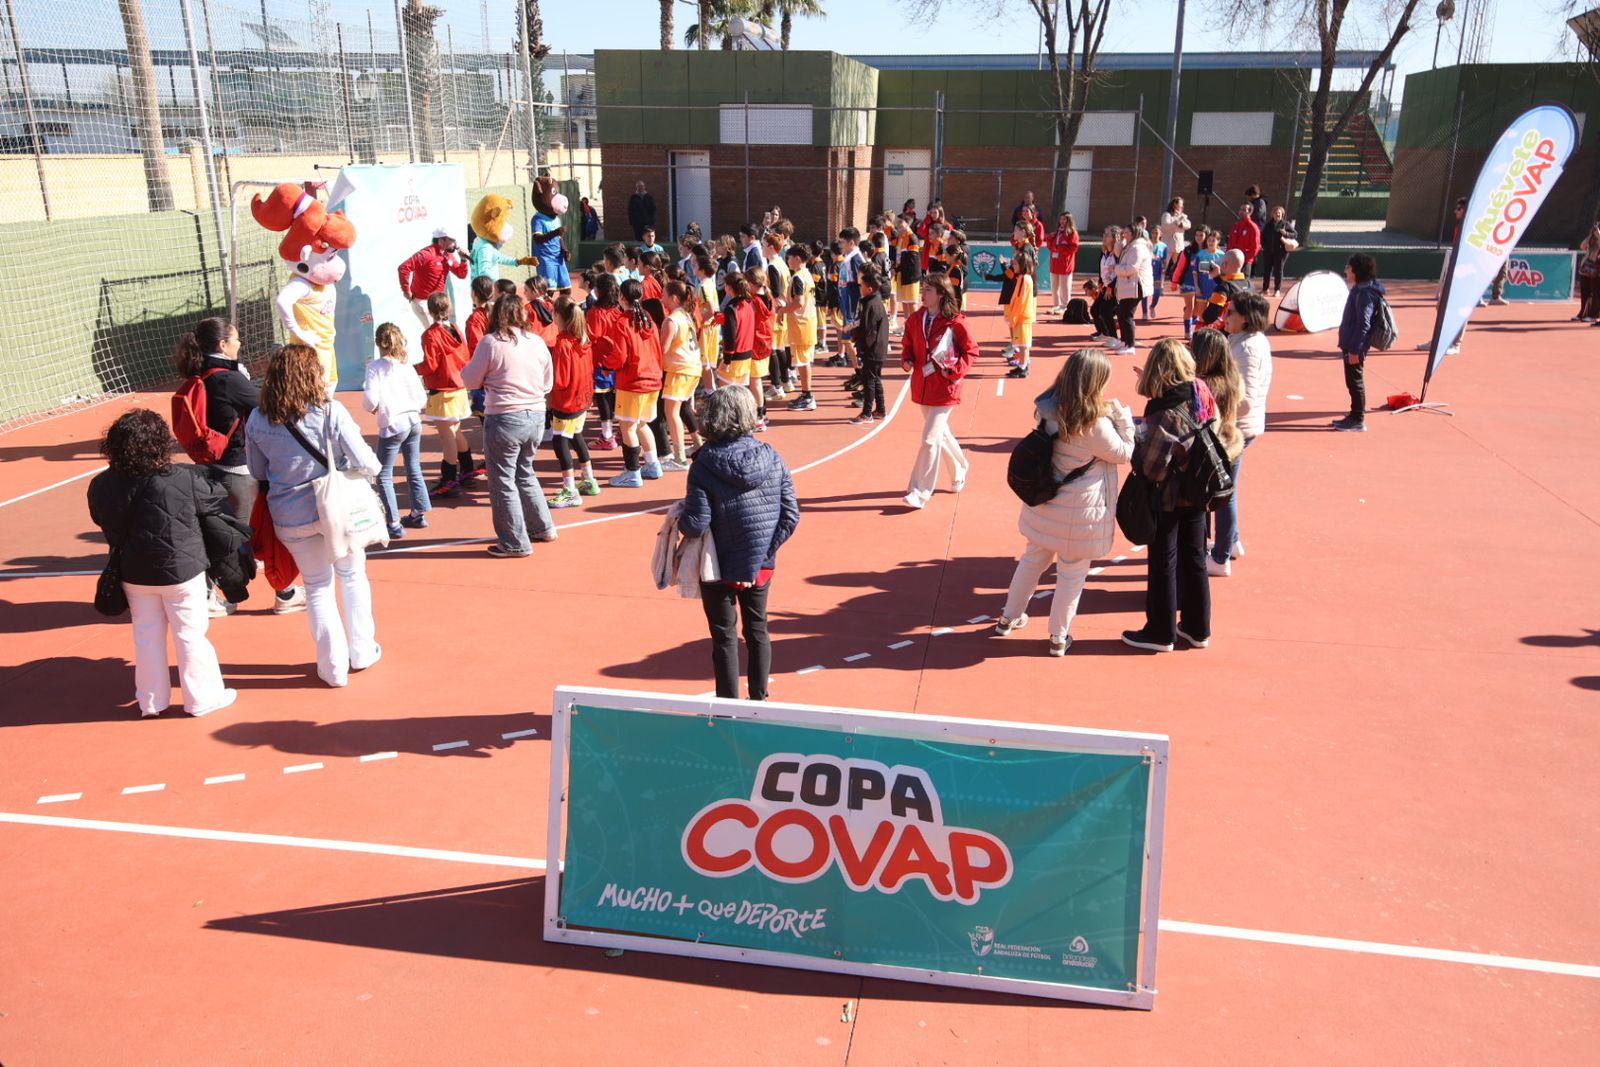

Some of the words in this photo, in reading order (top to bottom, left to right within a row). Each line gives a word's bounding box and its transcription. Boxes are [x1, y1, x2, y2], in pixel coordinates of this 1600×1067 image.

[1468, 131, 1538, 248] Muévete
[1493, 139, 1555, 245] COVAP
[1508, 270, 1543, 286] VAP
[1510, 261, 1528, 270] PA
[761, 762, 935, 823] COPA
[686, 804, 1008, 899] COVAP
